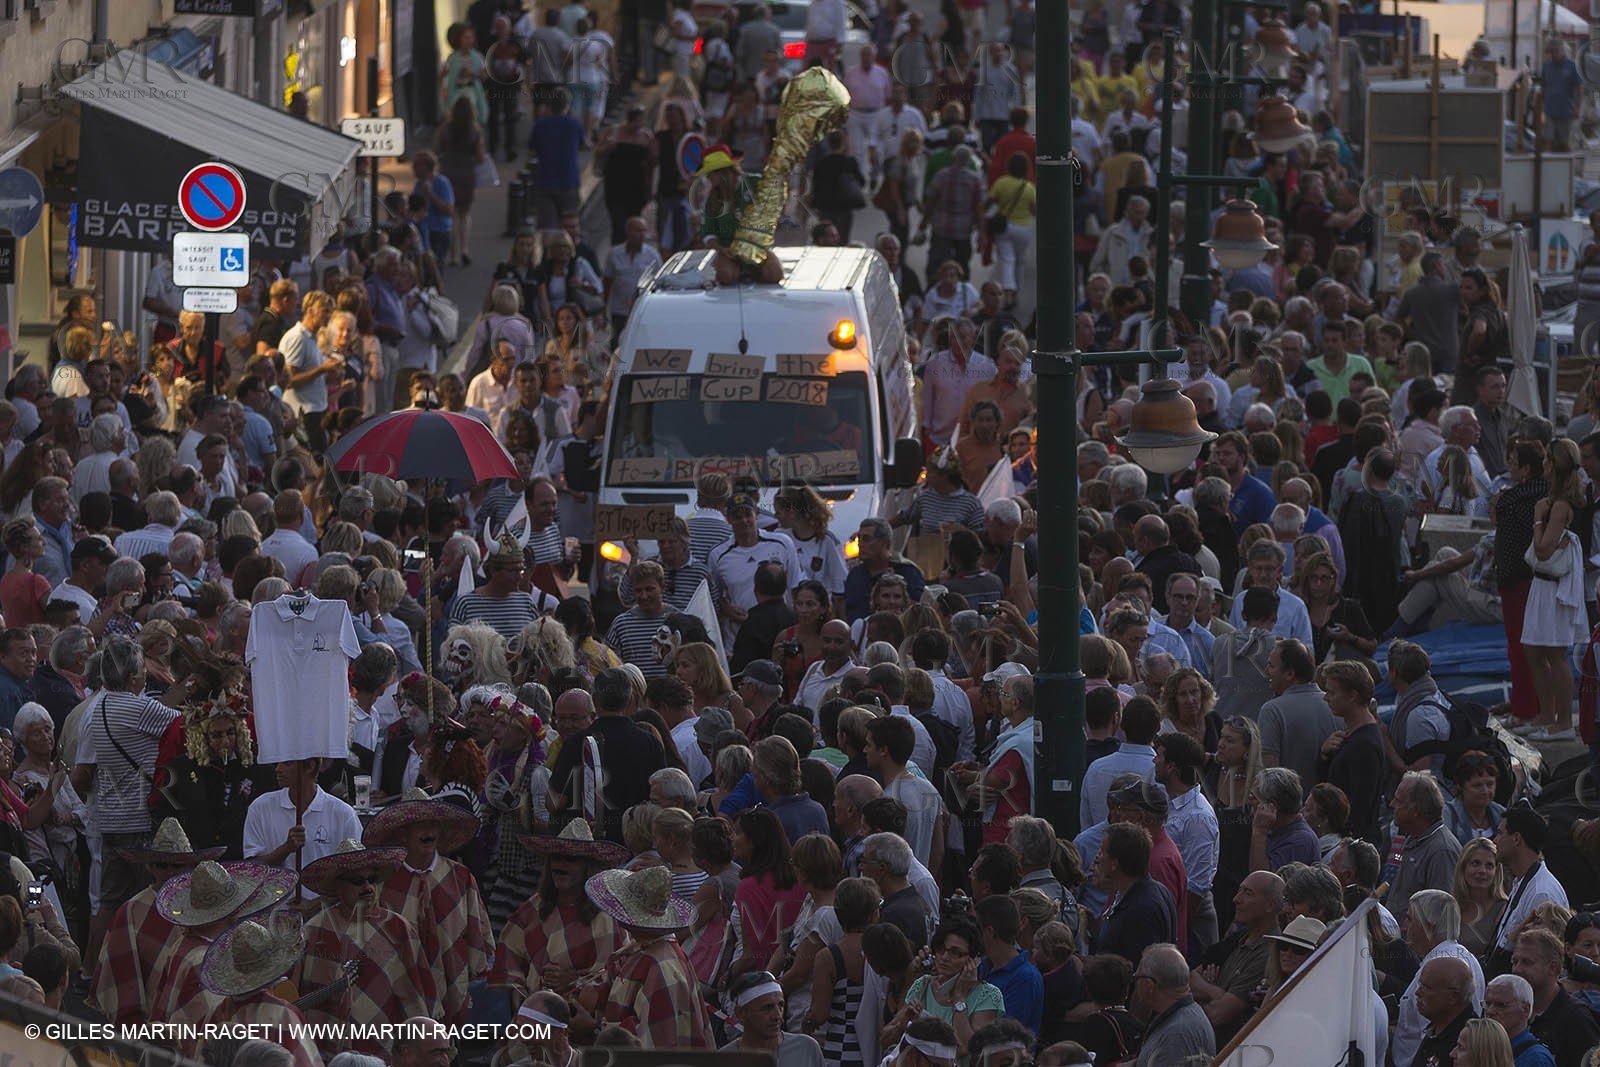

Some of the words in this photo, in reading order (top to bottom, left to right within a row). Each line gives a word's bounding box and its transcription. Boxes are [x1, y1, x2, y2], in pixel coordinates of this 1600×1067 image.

[353, 123, 392, 135] SAUF
[361, 139, 393, 151] AXIS
[643, 350, 681, 369] We
[708, 353, 760, 379] bring
[781, 354, 831, 375] the
[637, 378, 690, 401] World
[703, 379, 753, 400] Cup
[769, 378, 826, 405] 2018
